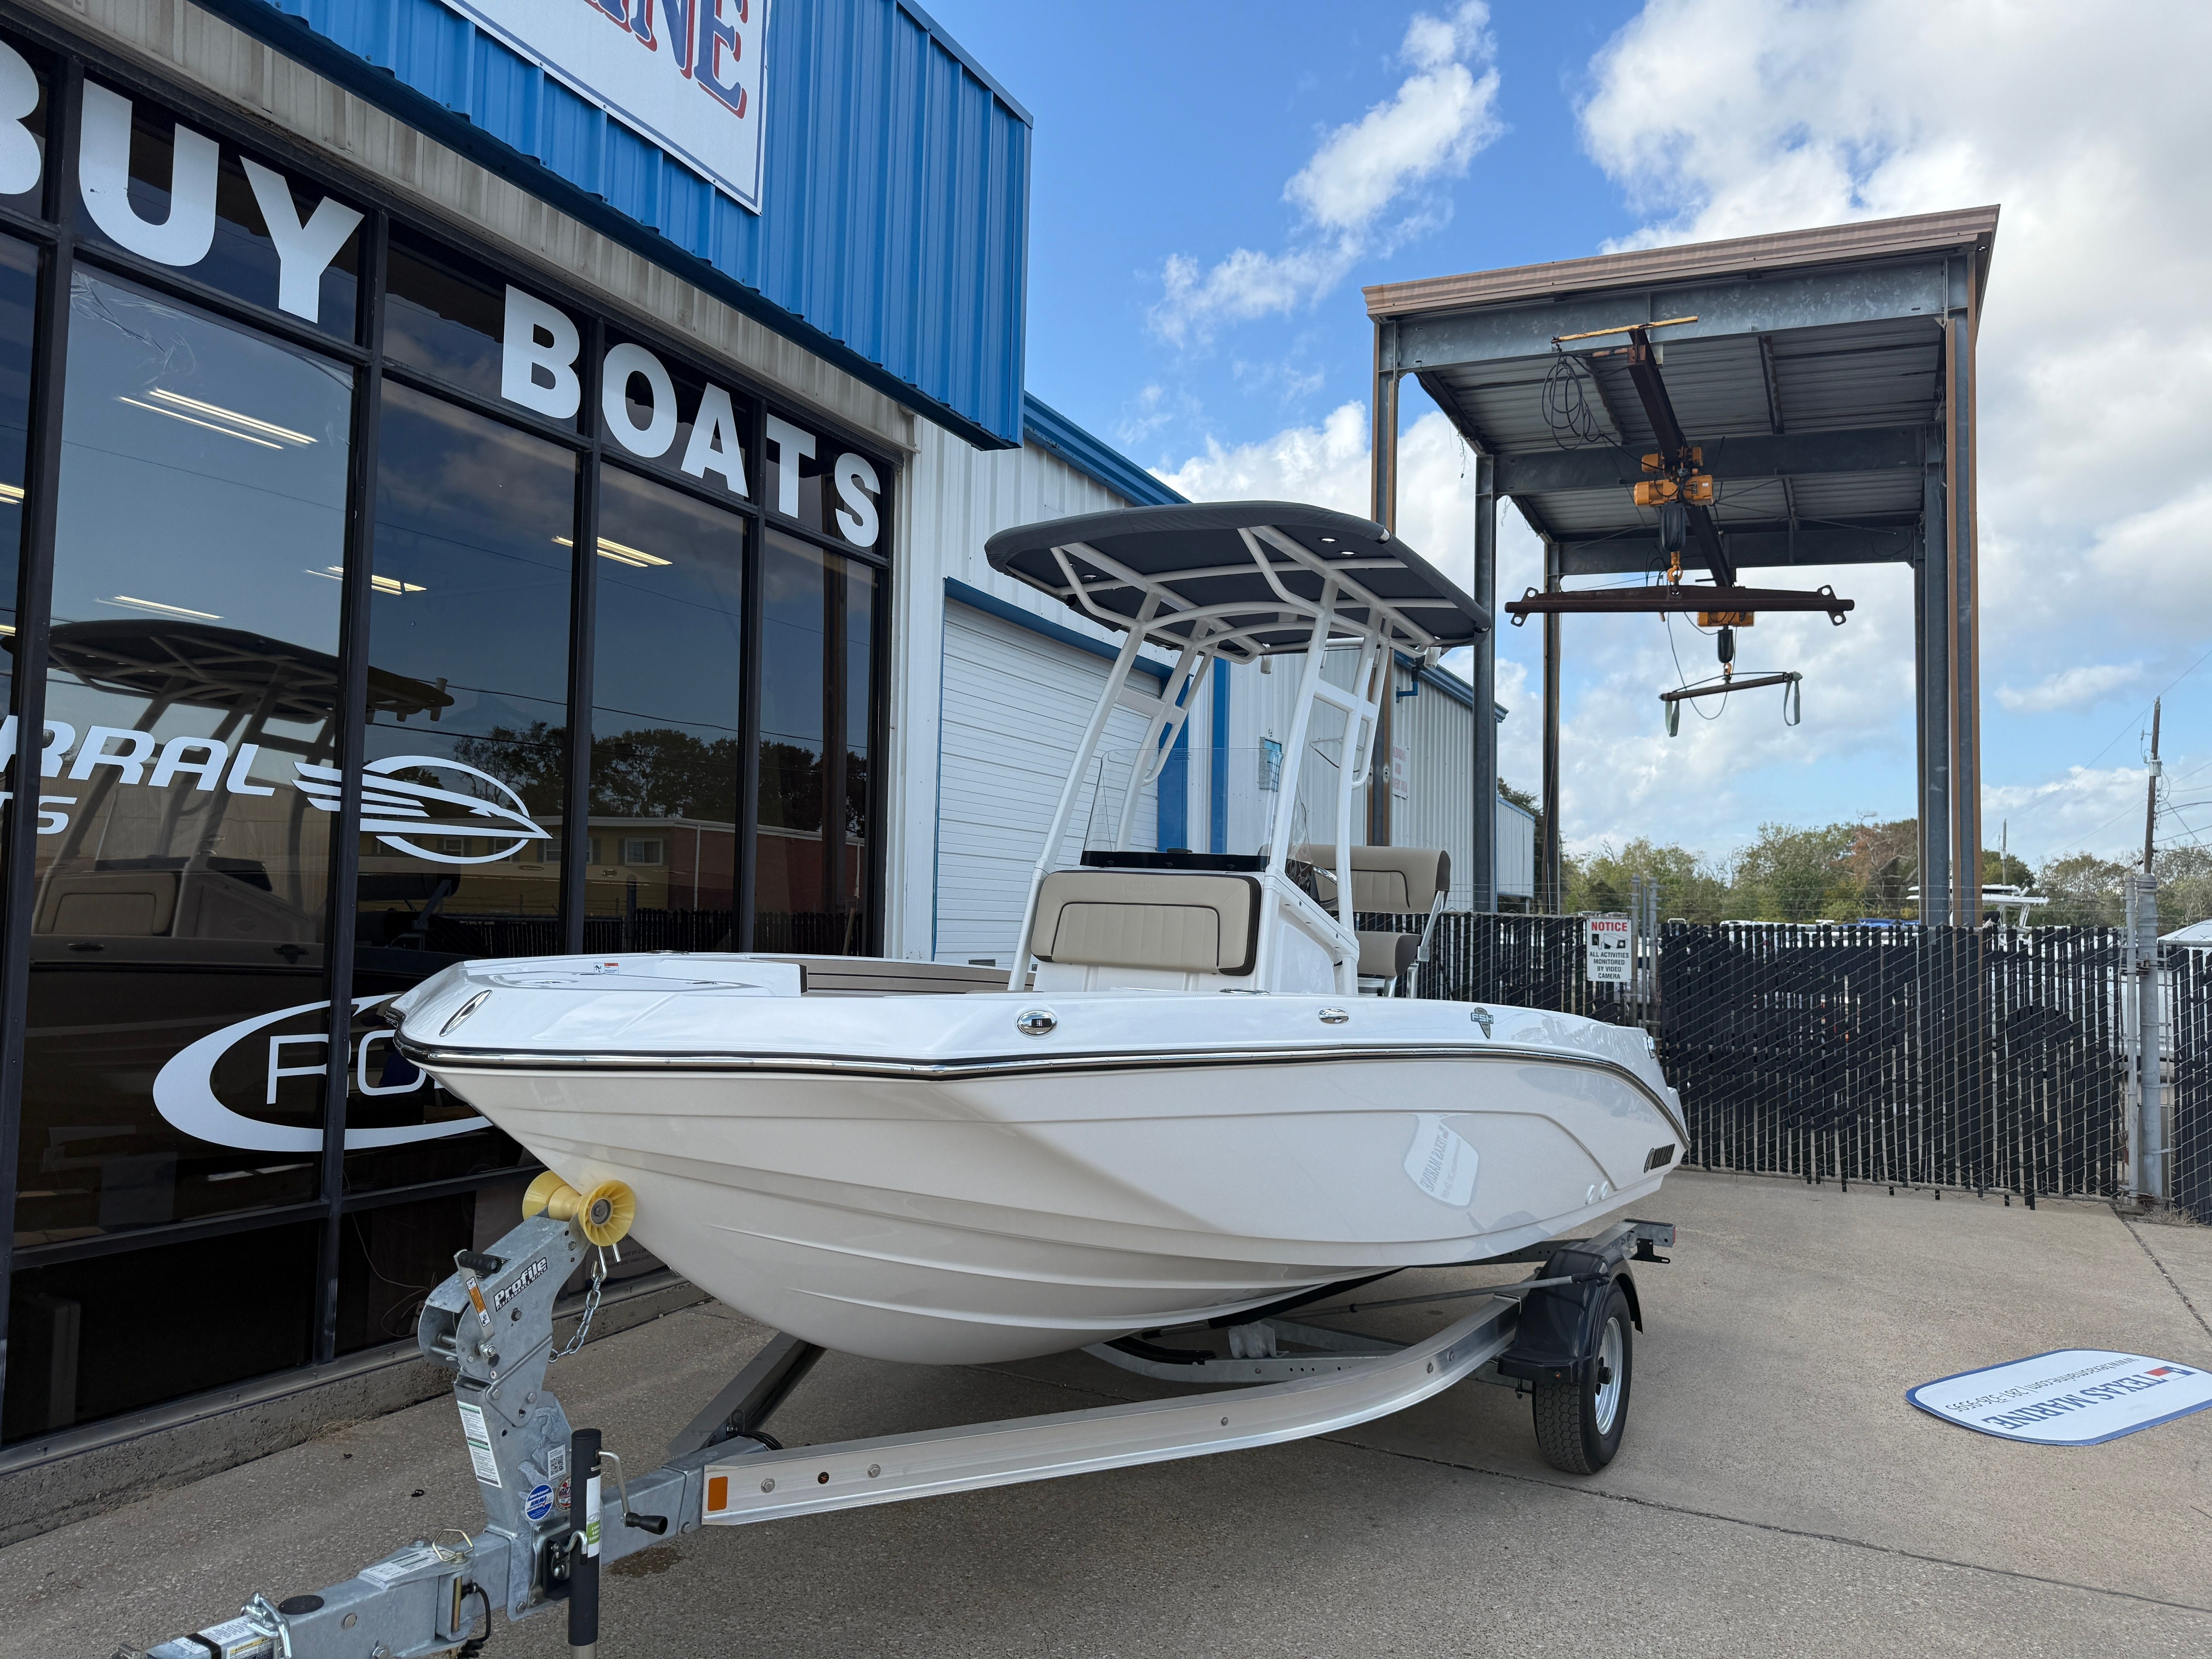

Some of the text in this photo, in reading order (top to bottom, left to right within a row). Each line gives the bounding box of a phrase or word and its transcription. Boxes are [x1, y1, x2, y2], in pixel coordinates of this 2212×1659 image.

[501, 284, 881, 548] BOATS
[1591, 922, 1627, 931] NOTICE
[1471, 1013, 1493, 1024] FSH
[494, 1258, 546, 1307] Profile
[496, 1280, 530, 1310] PERFORMANCE
[531, 1266, 547, 1281] WINCH
[2026, 1357, 2140, 1389] www.texasmarine.com
[1945, 1389, 2028, 1412] 281-326-9595
[1981, 1374, 2169, 1430] TEXAS MARINE
